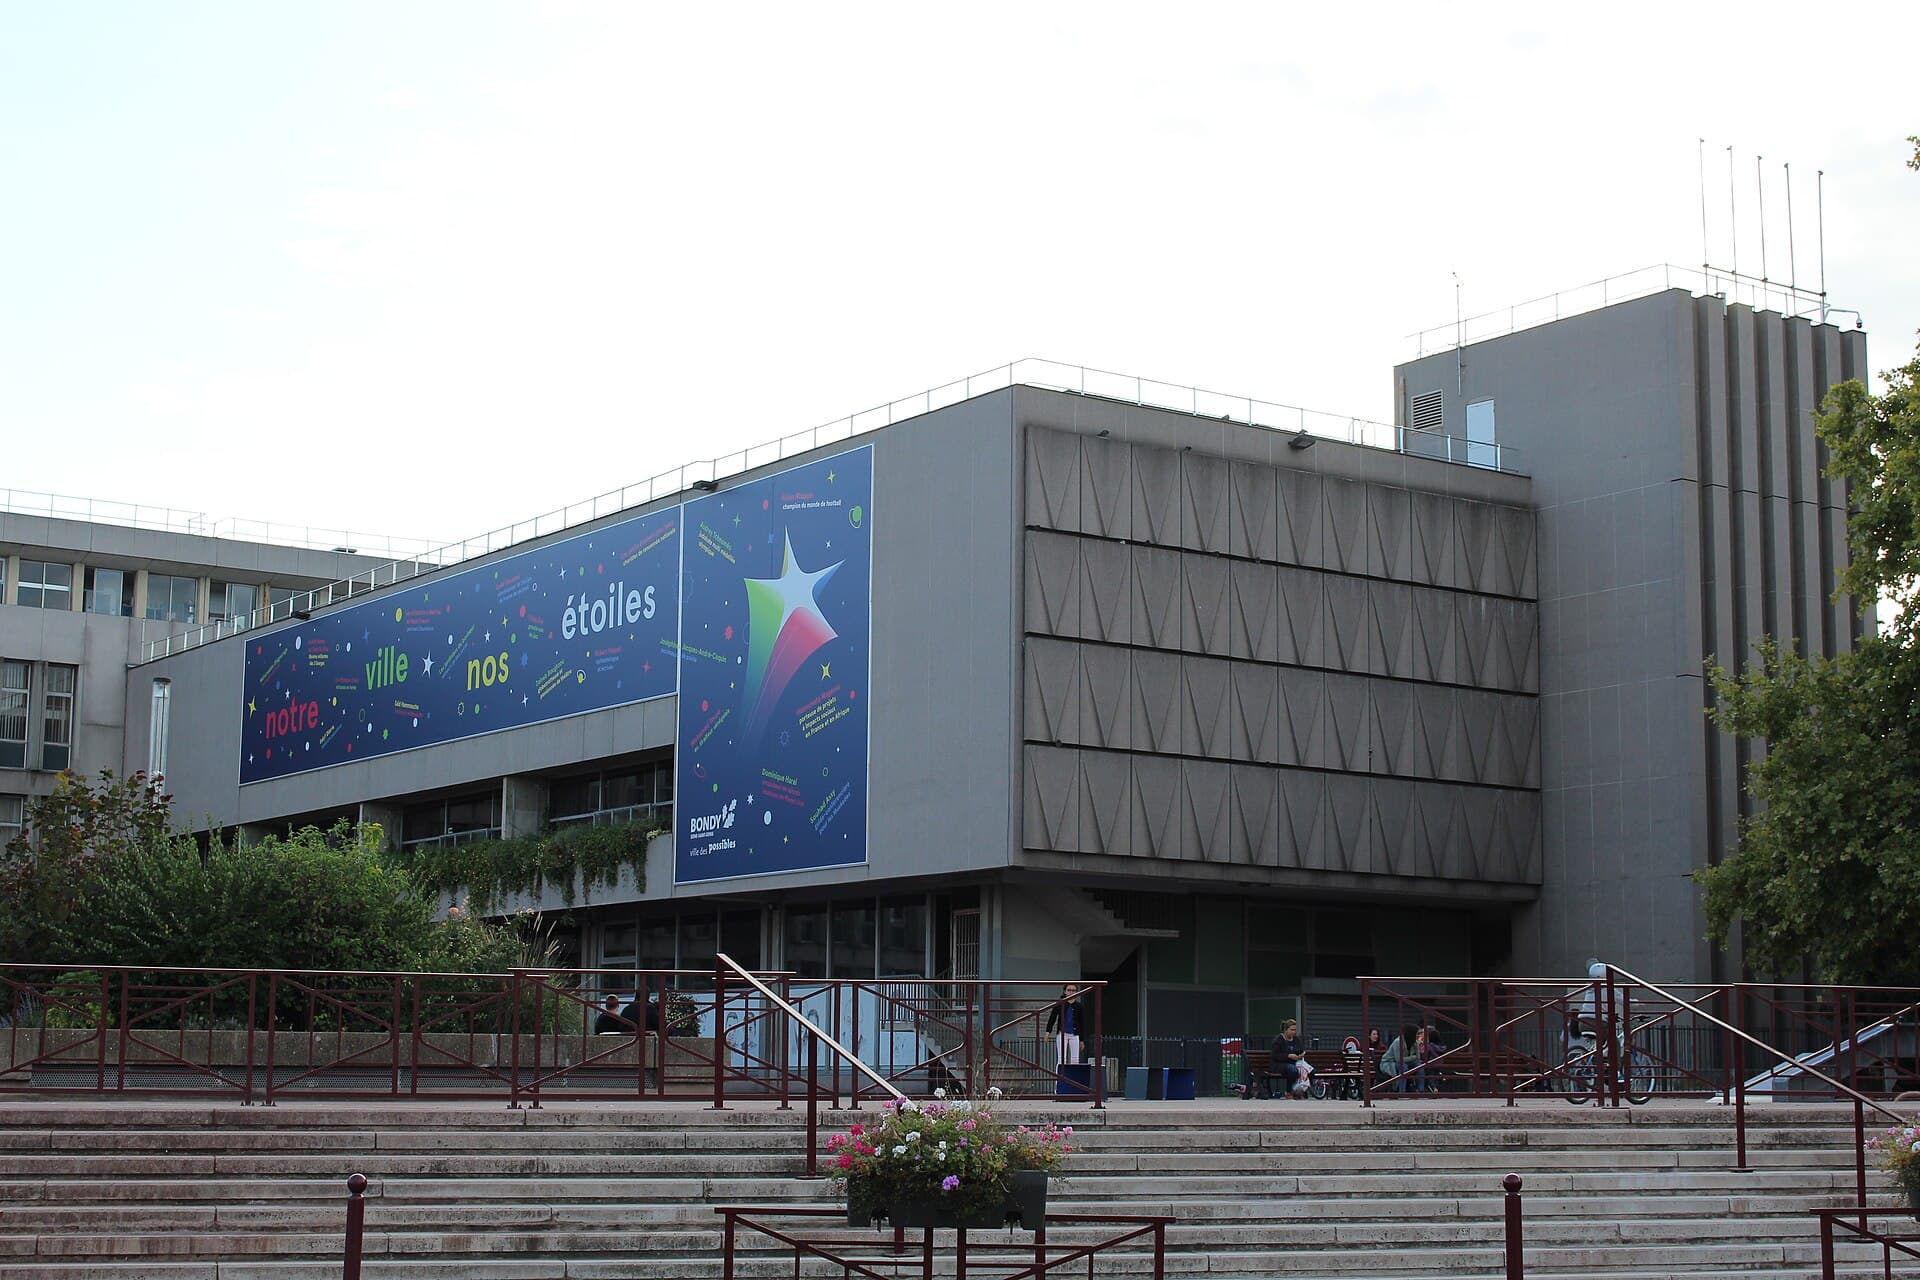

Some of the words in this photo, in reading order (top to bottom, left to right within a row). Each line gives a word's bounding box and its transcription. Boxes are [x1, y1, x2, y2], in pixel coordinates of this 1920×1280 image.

[562, 580, 656, 640] étoiles
[365, 645, 409, 691] ville
[466, 651, 510, 692] nos
[265, 696, 319, 739] notre
[690, 814, 722, 833] BONDY
[690, 847, 699, 857] ville
[700, 846, 708, 855] des
[708, 838, 736, 854] possibles
